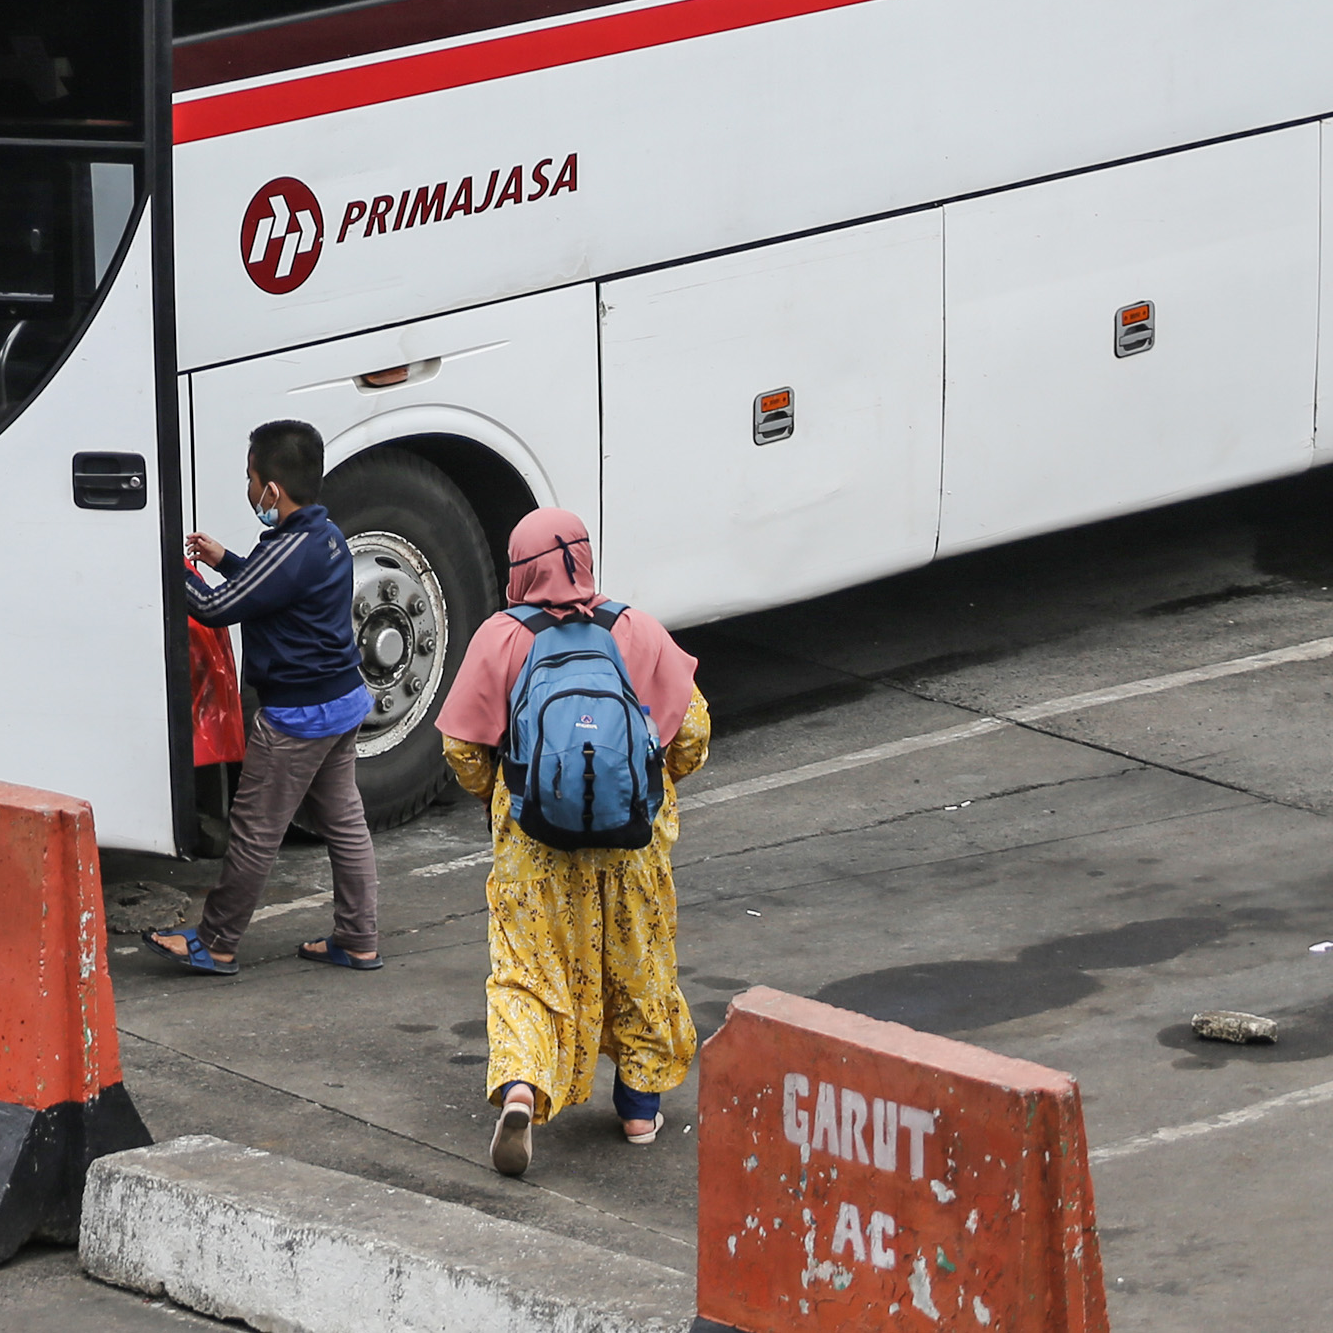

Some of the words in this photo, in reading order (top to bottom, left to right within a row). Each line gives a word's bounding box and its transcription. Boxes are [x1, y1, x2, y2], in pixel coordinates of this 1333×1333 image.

[336, 152, 579, 245] PRIMAJASA
[782, 1072, 936, 1182] GARUT
[832, 1201, 896, 1270] AC
